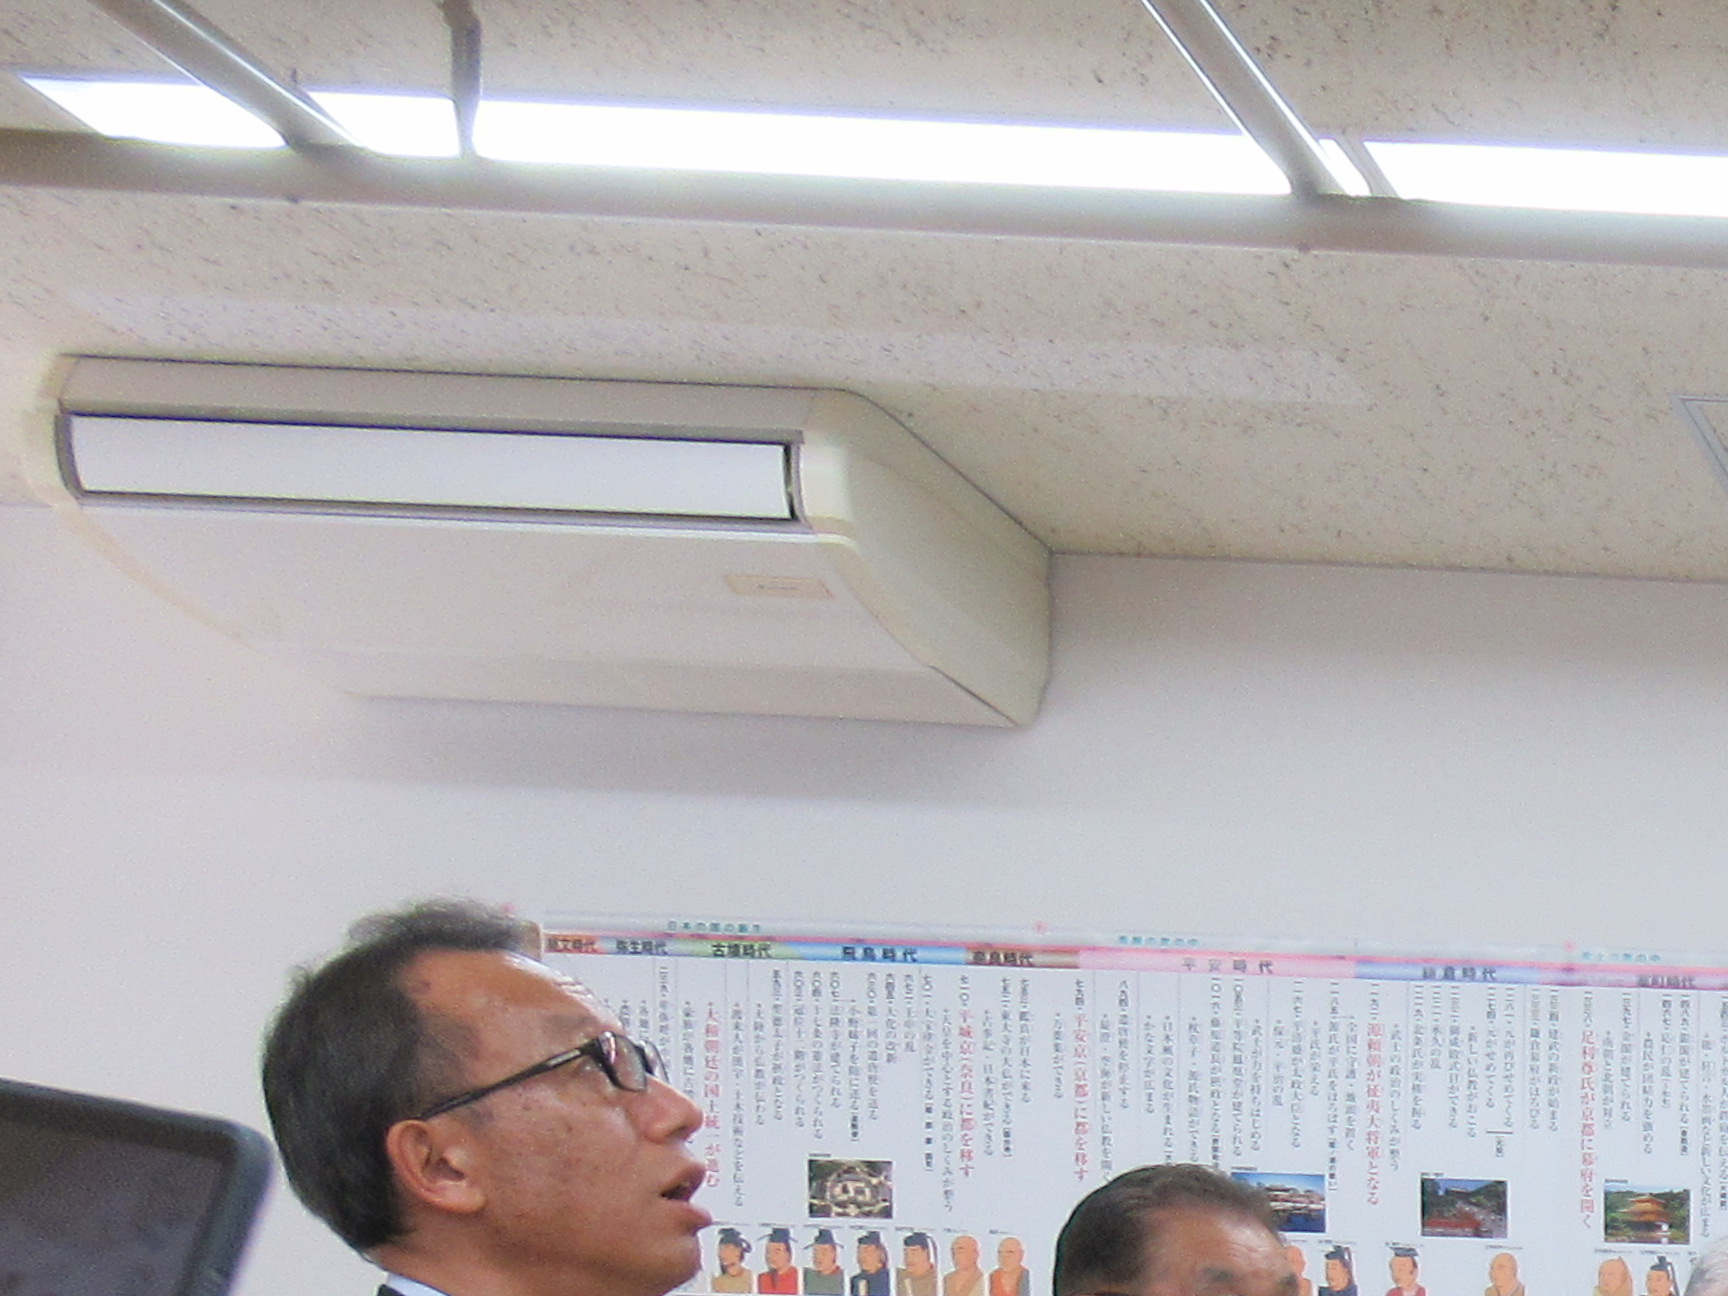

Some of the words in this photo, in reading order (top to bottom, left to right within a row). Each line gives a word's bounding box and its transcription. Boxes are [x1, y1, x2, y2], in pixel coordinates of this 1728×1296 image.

[711, 941, 773, 959] 古墳時代
[971, 949, 1035, 967] 奈良時代
[1181, 956, 1275, 975] 平安時代
